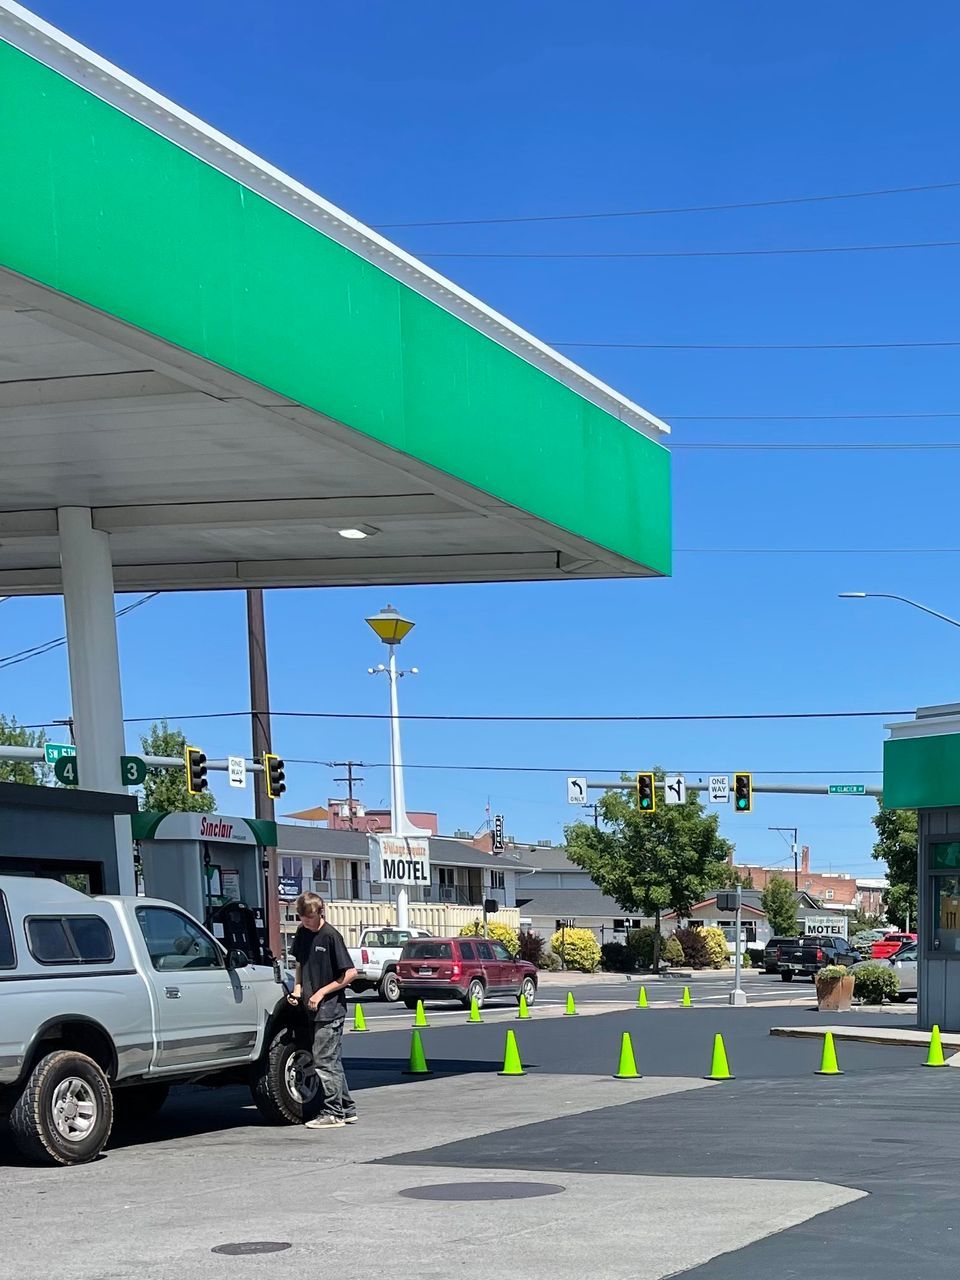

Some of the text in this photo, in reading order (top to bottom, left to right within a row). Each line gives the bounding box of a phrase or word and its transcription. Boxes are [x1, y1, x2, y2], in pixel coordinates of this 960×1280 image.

[48, 749, 59, 759] SW
[231, 759, 242, 768] ONE
[63, 763, 75, 780] 4
[127, 762, 138, 779] 3
[231, 768, 243, 776] WAY
[201, 816, 234, 838] Sinclair
[383, 859, 428, 881] MOTEL
[256, 910, 261, 919] 3
[807, 925, 843, 935] MOTEL
